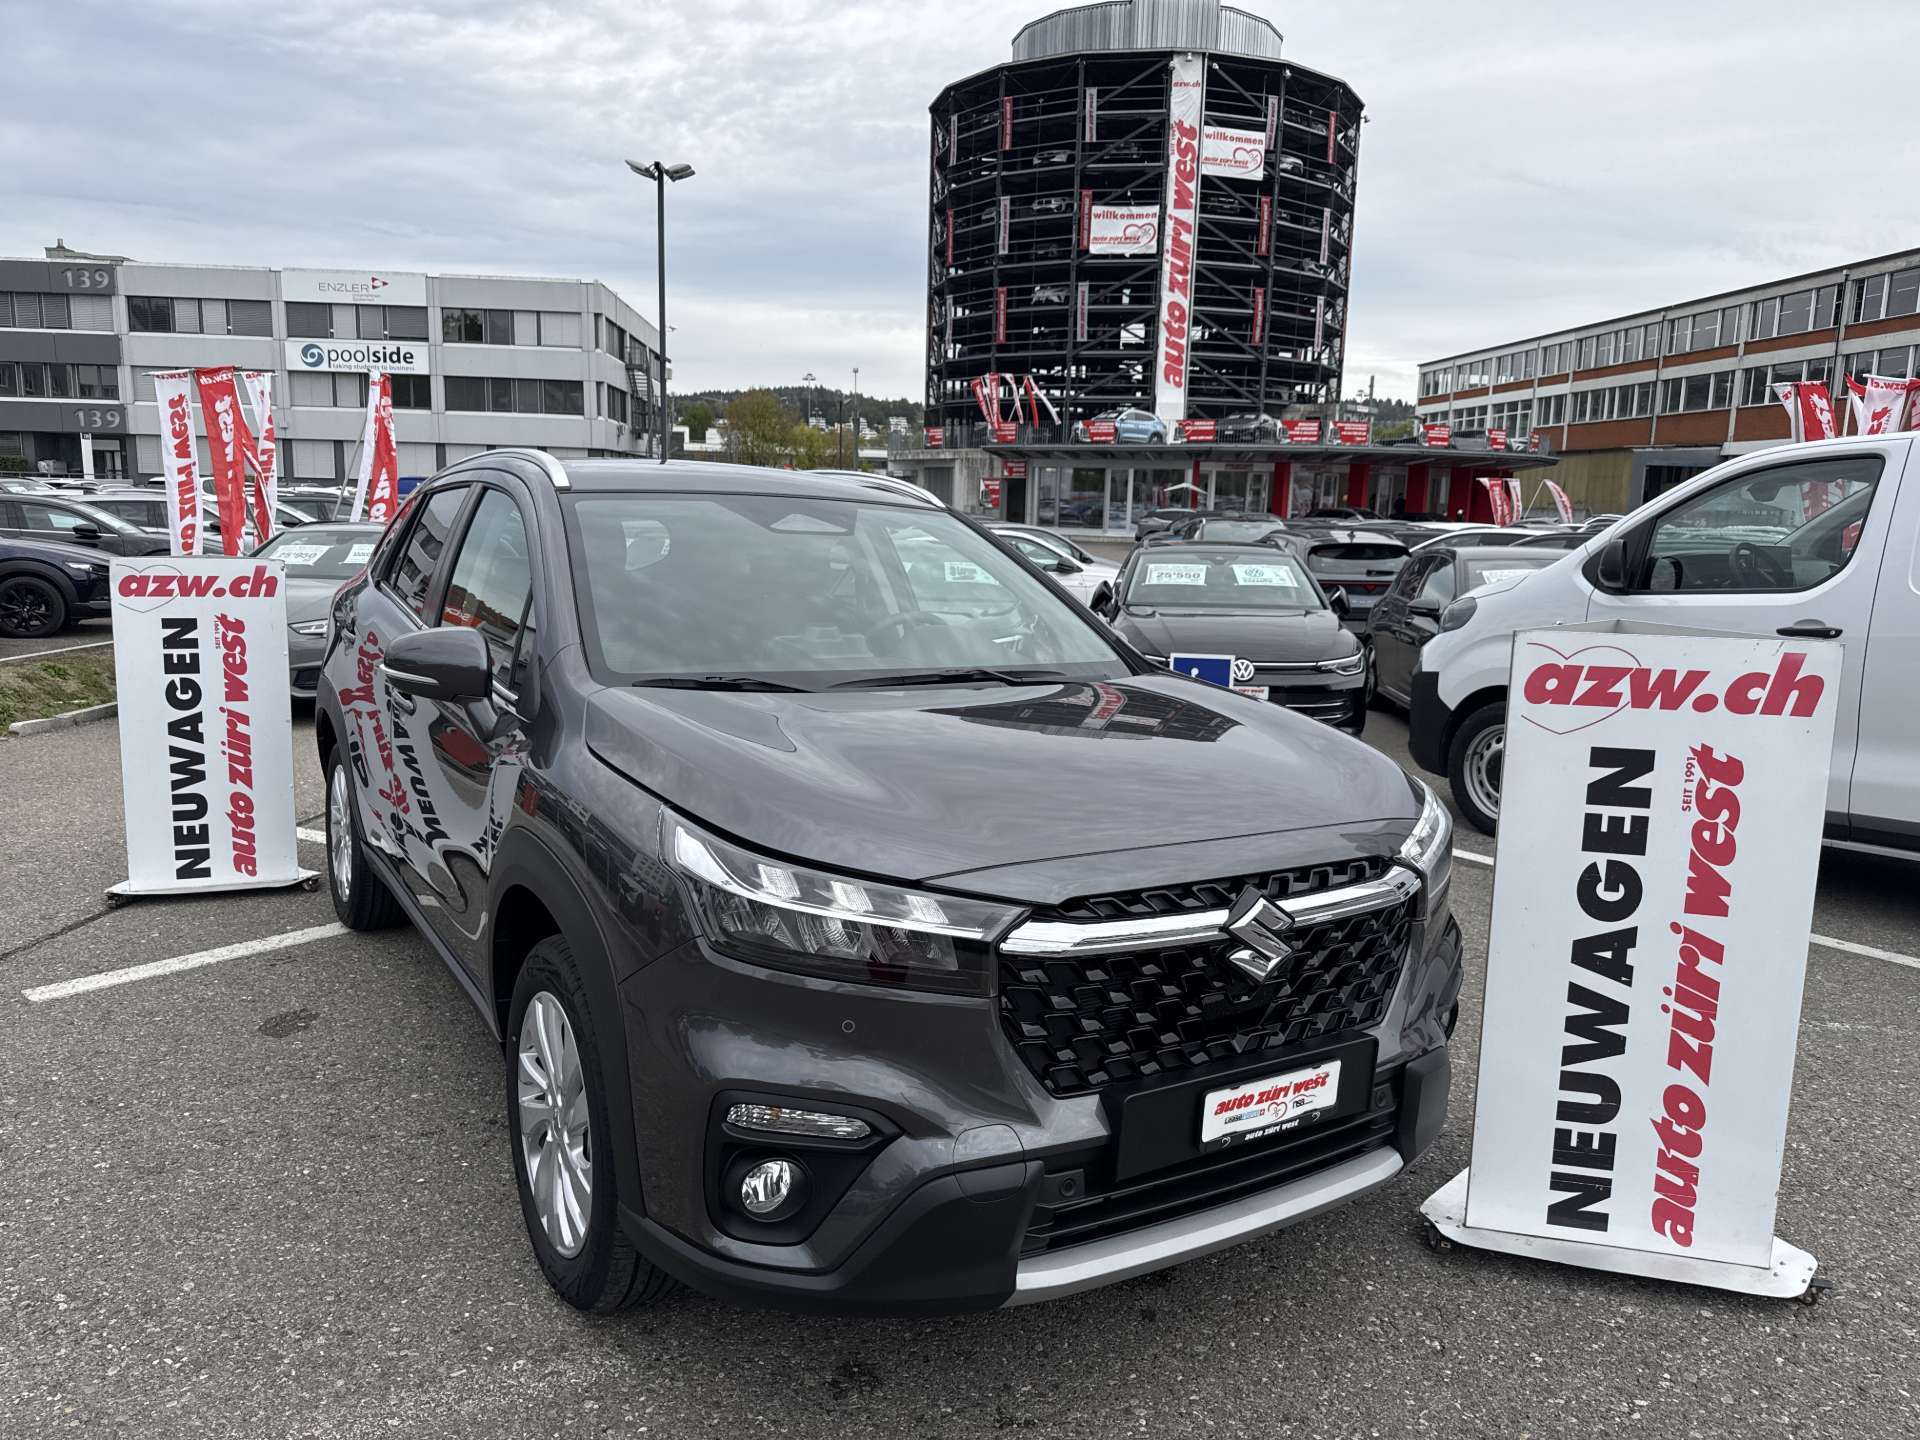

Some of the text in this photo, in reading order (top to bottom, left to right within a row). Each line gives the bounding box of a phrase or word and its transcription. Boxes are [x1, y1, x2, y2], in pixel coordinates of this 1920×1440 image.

[1173, 79, 1201, 88] azw.ch
[1204, 131, 1264, 145] willkommen
[1093, 210, 1157, 220] willkommen
[1162, 118, 1198, 389] auto züri west
[62, 268, 110, 289] 139
[318, 282, 370, 293] ENZLER
[327, 345, 415, 369] poolside
[74, 408, 121, 429] 139
[119, 566, 278, 597] azw.ch
[1524, 652, 1825, 717] azw.ch
[161, 617, 212, 880] NEUWAGEN
[214, 613, 257, 877] auto züri west
[1681, 756, 1696, 812] SEIT 1991
[1546, 746, 1656, 1233] NEUWAGEN
[1651, 742, 1745, 1248] auto züri west
[1214, 1093, 1255, 1116] auto
[1255, 1082, 1293, 1105] züri
[1293, 1071, 1330, 1095] west
